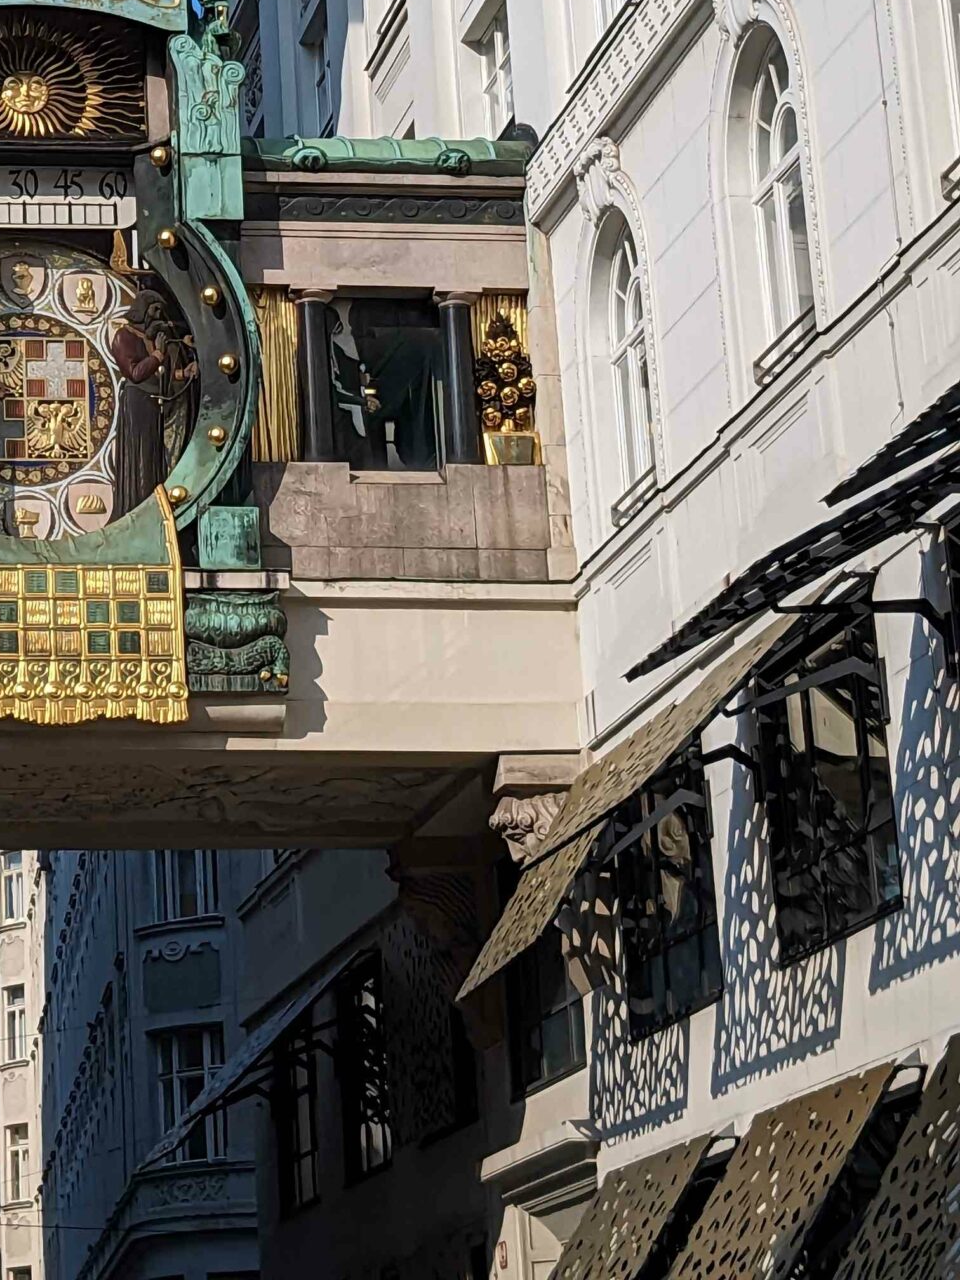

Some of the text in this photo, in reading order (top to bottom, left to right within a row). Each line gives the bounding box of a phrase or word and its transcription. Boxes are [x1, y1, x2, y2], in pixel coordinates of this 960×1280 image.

[8, 170, 39, 200] 30
[53, 169, 84, 200] 45
[98, 171, 128, 200] 60
